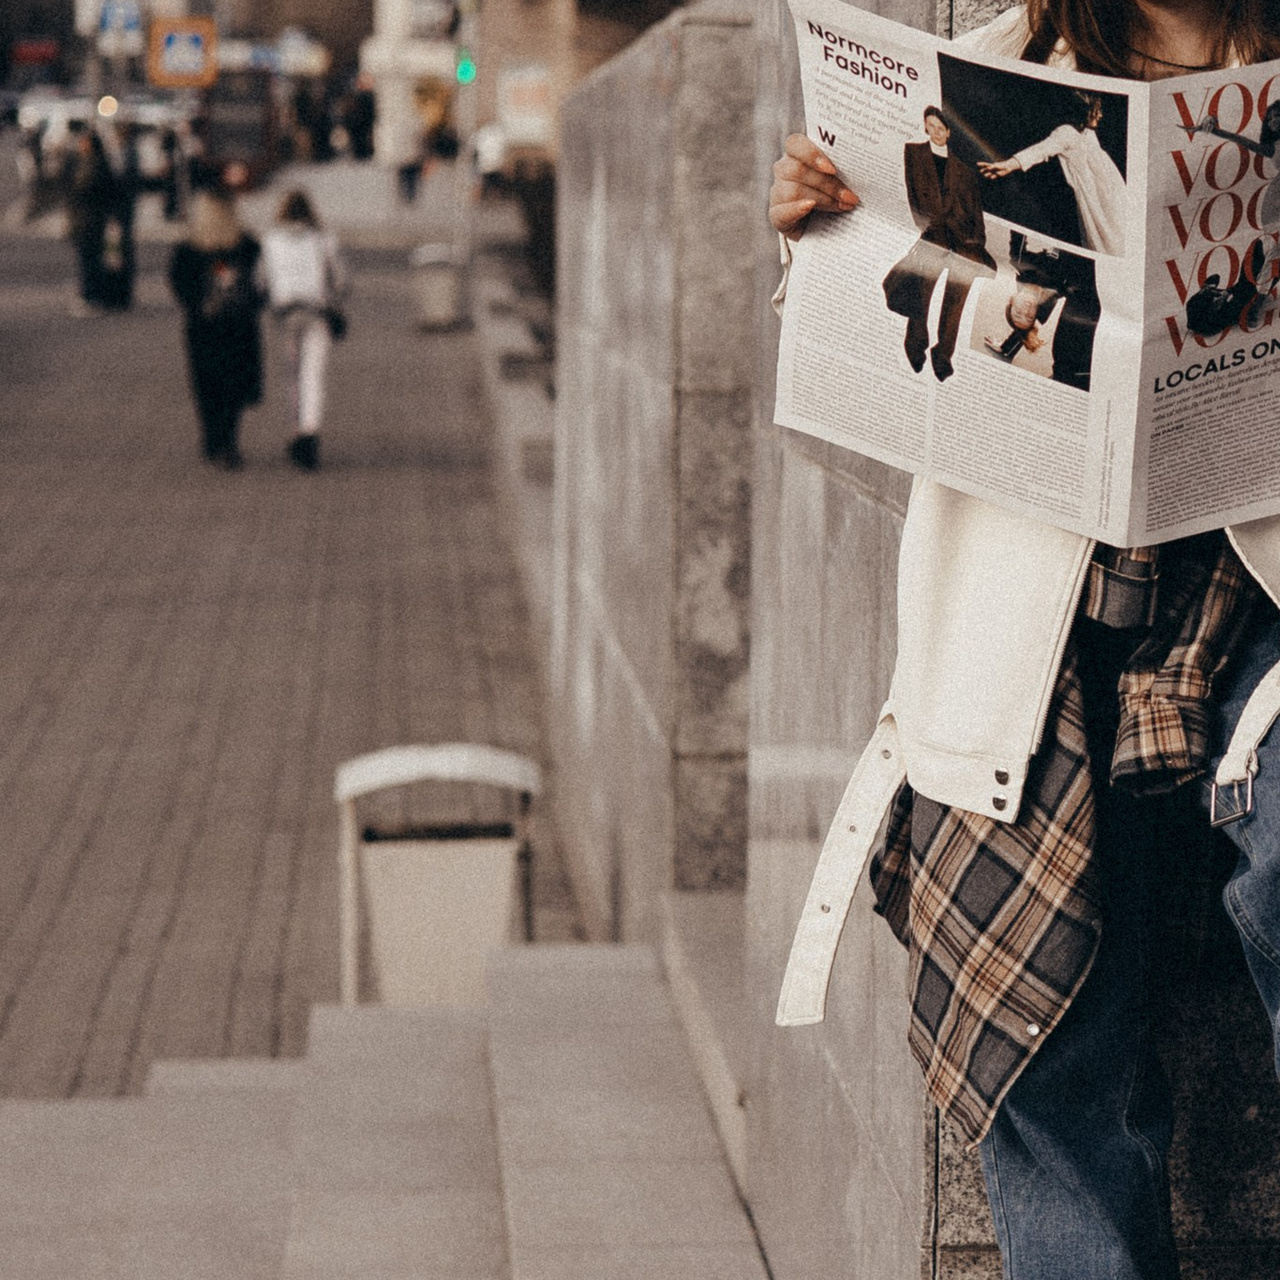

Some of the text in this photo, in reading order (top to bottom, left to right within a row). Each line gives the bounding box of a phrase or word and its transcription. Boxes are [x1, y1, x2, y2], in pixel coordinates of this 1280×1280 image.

[807, 20, 919, 81] Normcore
[823, 45, 907, 98] Fashion
[818, 125, 836, 146] W
[1154, 349, 1246, 394] LOCALS
